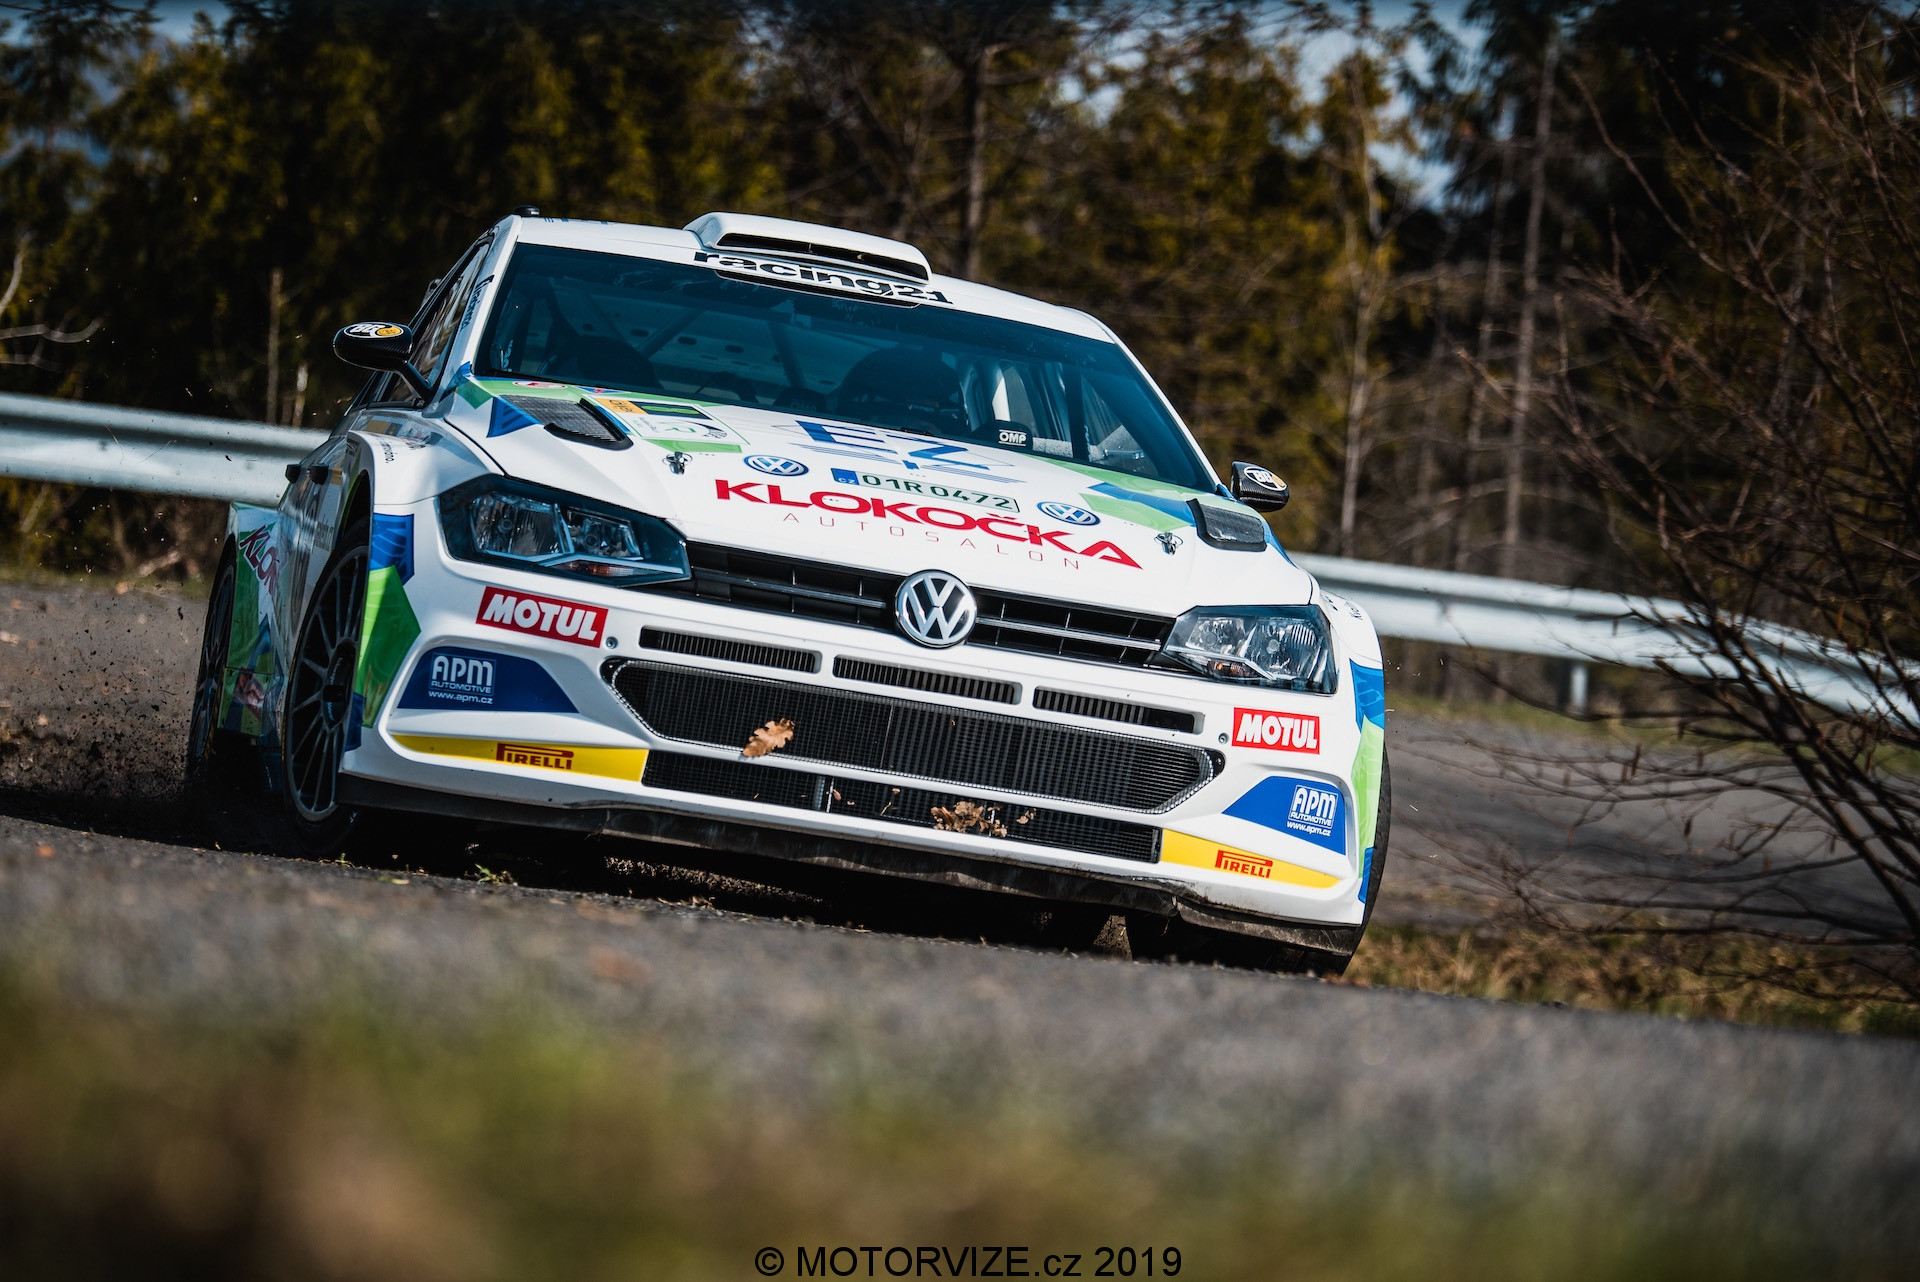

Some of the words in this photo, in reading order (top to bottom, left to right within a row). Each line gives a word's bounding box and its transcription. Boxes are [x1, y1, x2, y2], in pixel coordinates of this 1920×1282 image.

[694, 251, 954, 305] racing21
[999, 431, 1027, 444] OMP
[862, 474, 924, 494] 01R
[930, 486, 1013, 510] 0472
[715, 479, 1143, 570] KLOKOČKA
[783, 512, 1079, 570] AUTOSALON
[482, 593, 598, 641] MOTUL
[431, 680, 492, 694] AUTOMOTIVE
[432, 655, 494, 687] APM
[428, 690, 493, 705] www.apm.cz
[1236, 713, 1318, 749] MOTUL
[496, 742, 575, 770] PIRELLI
[1290, 811, 1333, 827] AUTOMOTIVE
[1292, 787, 1336, 819] APM
[1286, 820, 1331, 837] www.apm.cz
[1215, 850, 1273, 879] PIRELLI
